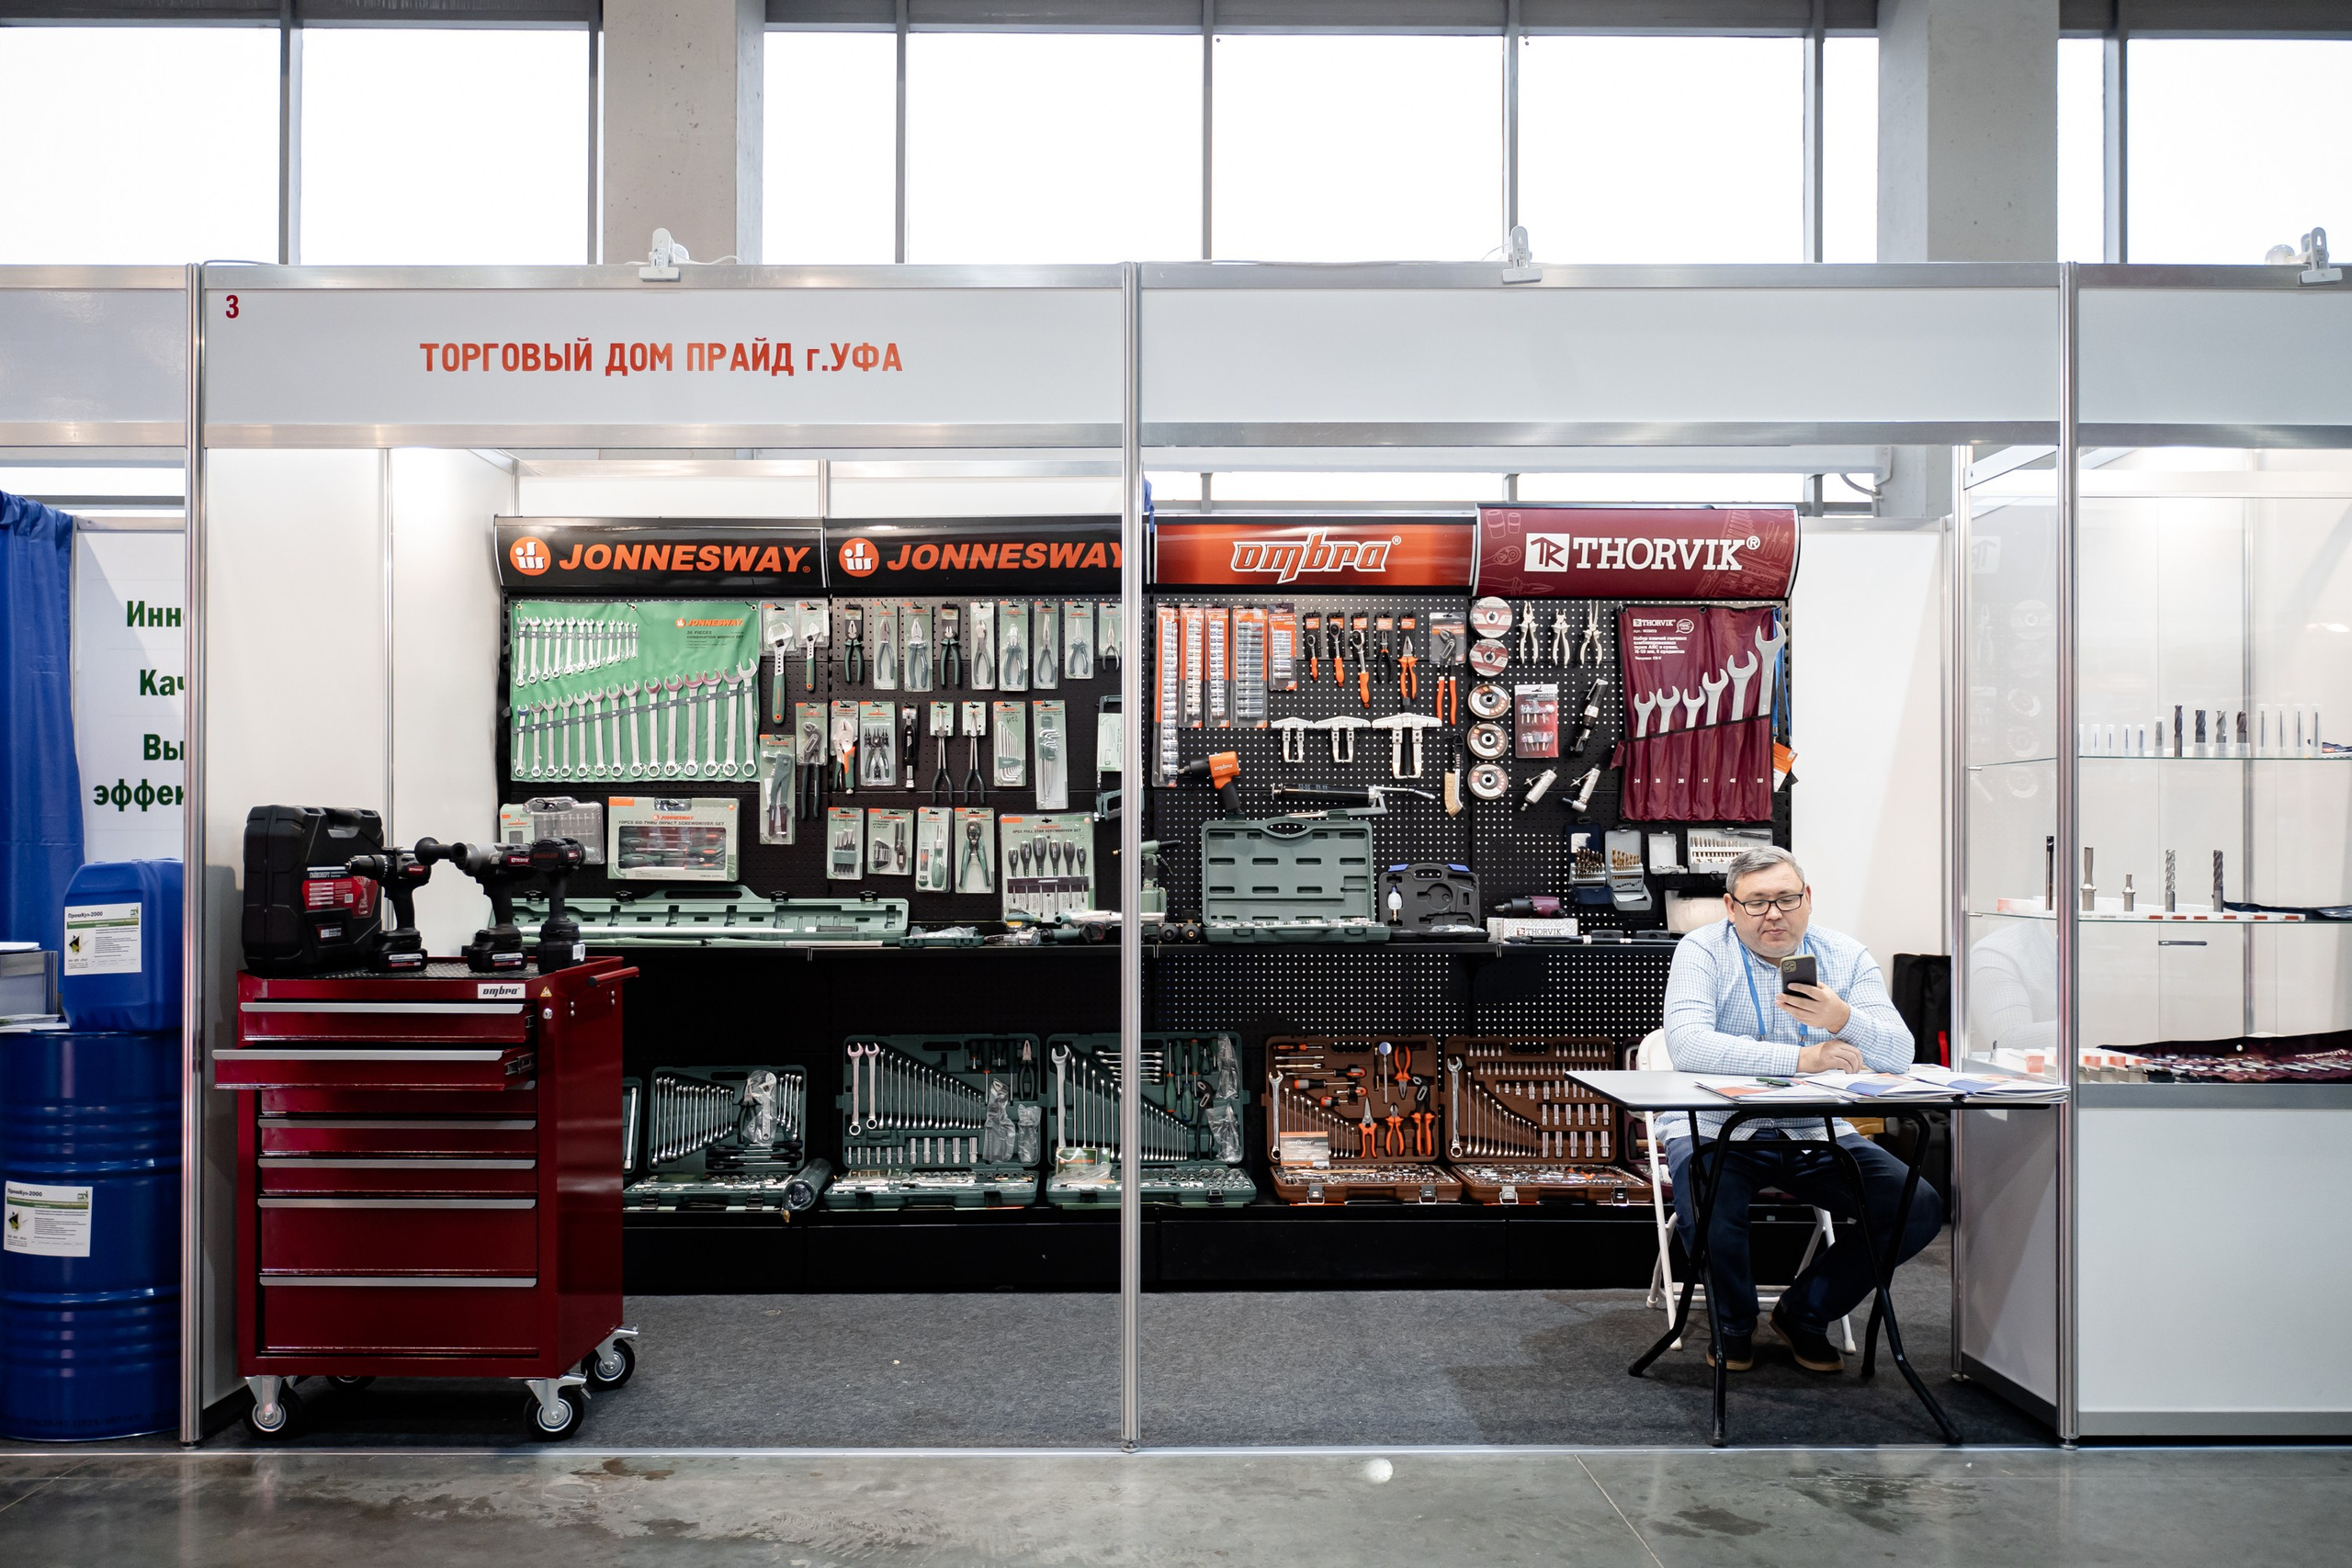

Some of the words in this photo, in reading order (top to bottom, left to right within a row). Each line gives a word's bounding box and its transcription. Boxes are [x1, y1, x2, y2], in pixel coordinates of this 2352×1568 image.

[226, 294, 240, 319] 3
[419, 336, 594, 373] ТОРГОВЫЙ
[605, 342, 673, 378] ДОМ
[686, 336, 795, 378] ПРАЙД
[807, 342, 904, 373] г.УФА
[559, 543, 811, 573] JONNESWAY
[1572, 536, 1746, 571] THORVIK
[127, 600, 185, 627] Инн
[1526, 928, 1562, 936] THORVIK
[482, 985, 518, 998] ombra
